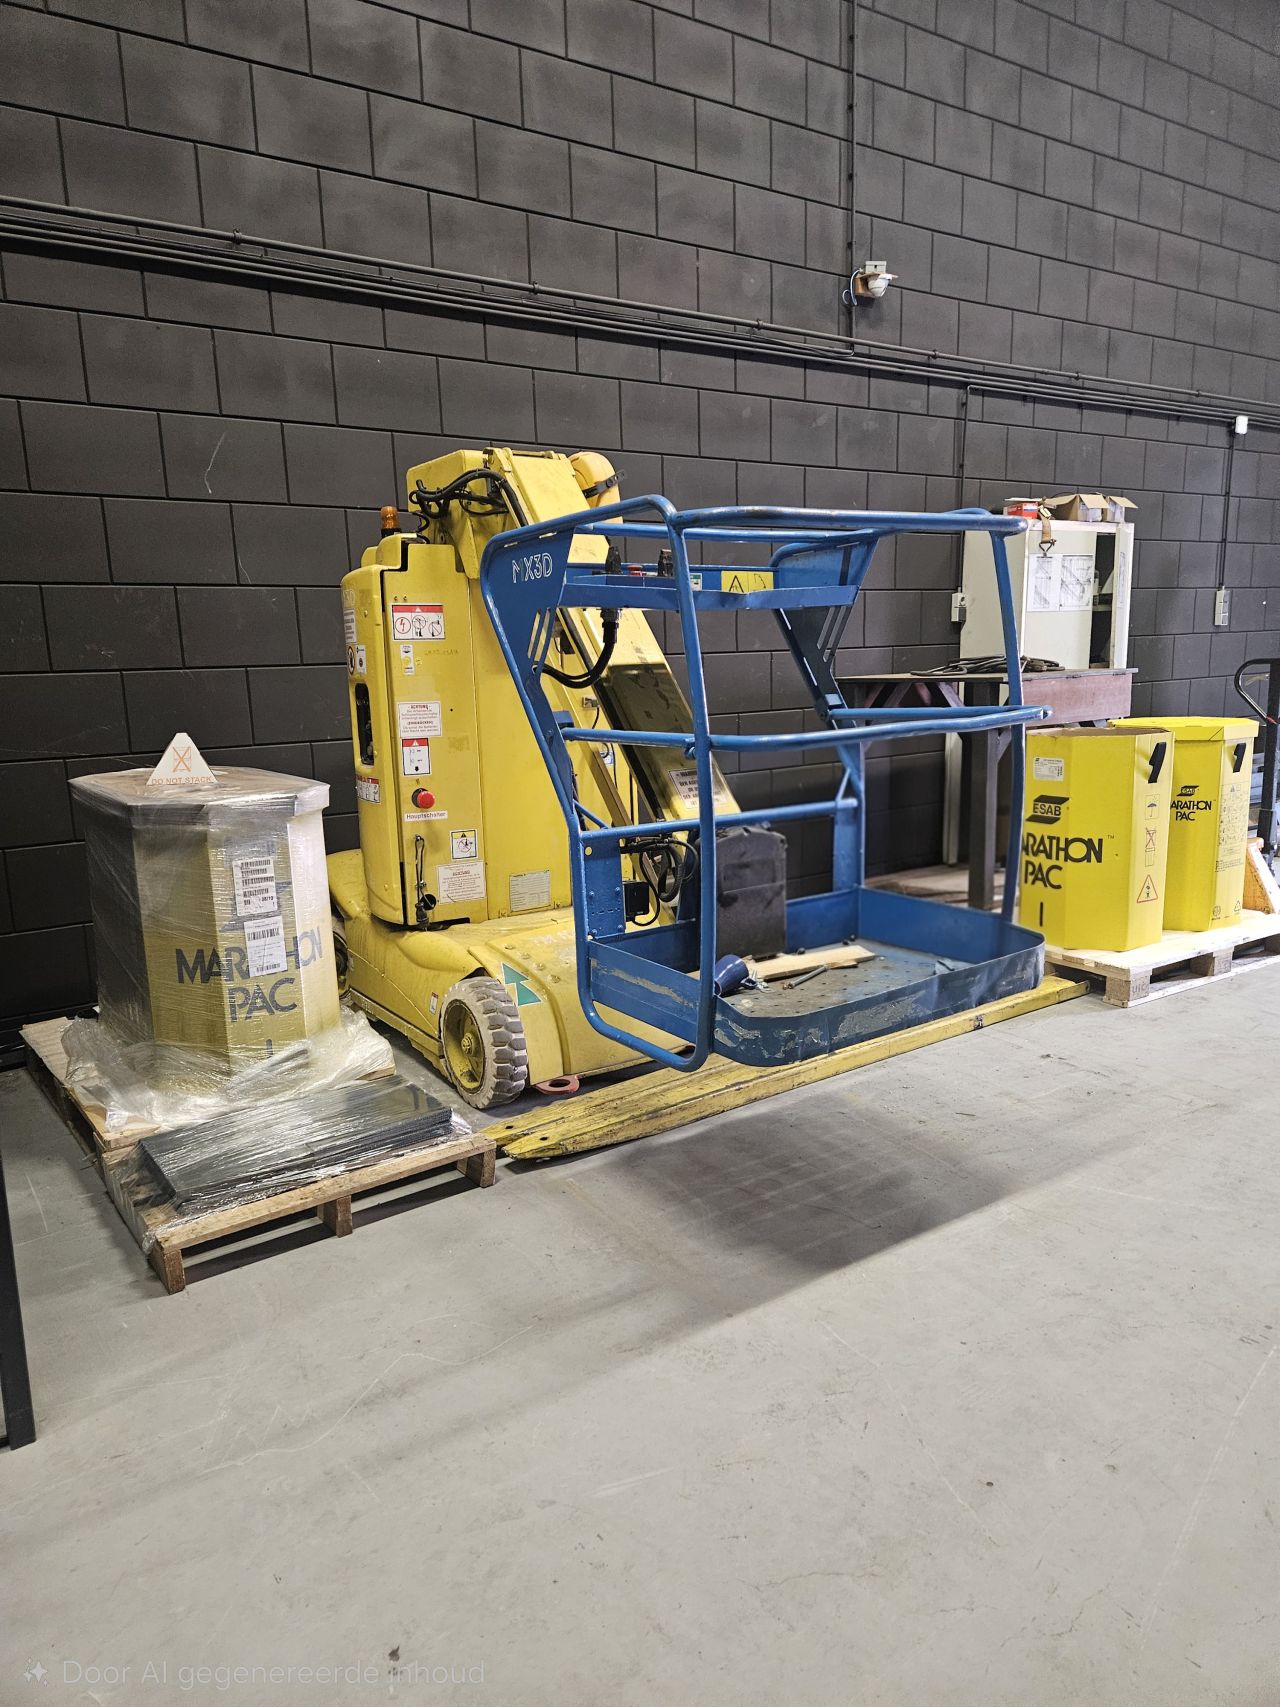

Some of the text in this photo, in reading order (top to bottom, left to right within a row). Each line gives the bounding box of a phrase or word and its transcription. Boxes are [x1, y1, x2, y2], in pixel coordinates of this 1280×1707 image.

[512, 552, 553, 583] MX3D
[1033, 802, 1062, 817] ESAB
[1170, 800, 1212, 811] ARATHON
[1175, 811, 1196, 822] PAC
[1024, 860, 1063, 890] PAC
[175, 926, 323, 985] MARHON
[227, 977, 298, 1023] PAC
